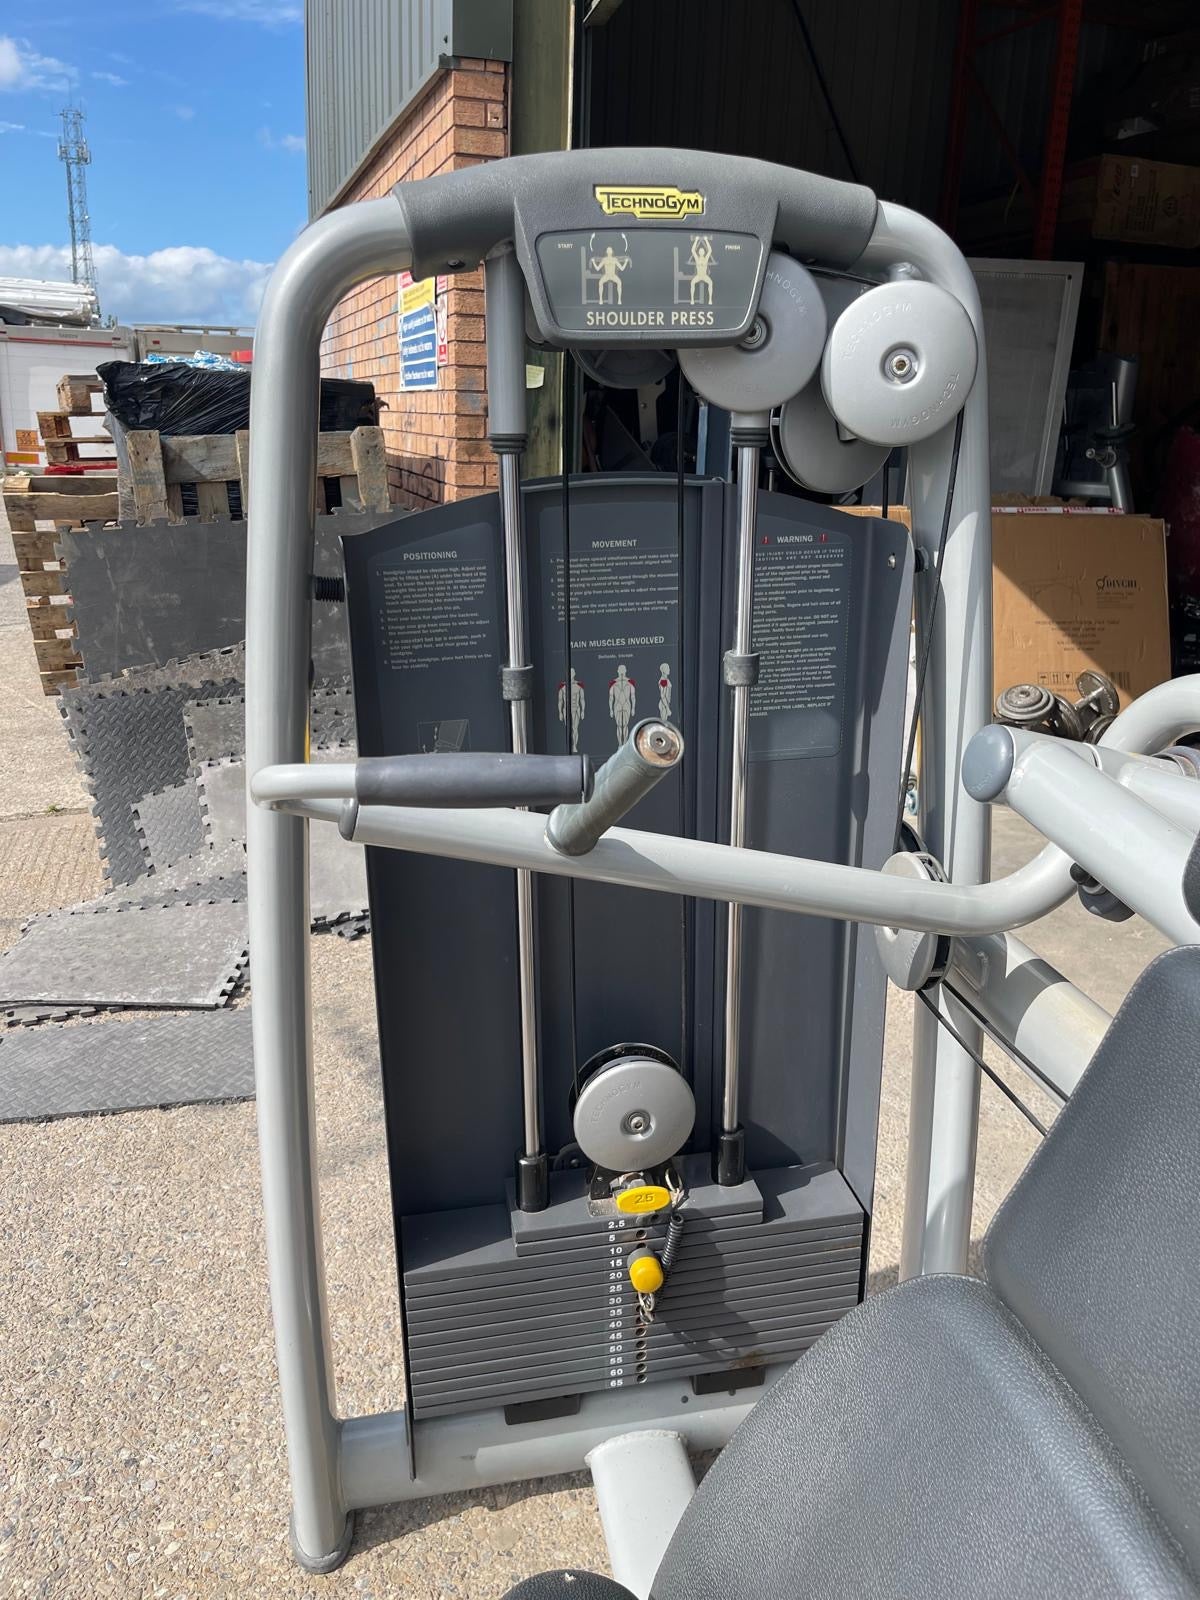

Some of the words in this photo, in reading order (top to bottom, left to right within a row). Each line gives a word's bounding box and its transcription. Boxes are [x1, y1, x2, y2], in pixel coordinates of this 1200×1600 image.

[600, 192, 699, 214] TECHNOGYM
[586, 311, 665, 326] SHOULDER
[671, 311, 714, 325] PRESS
[777, 535, 813, 543] WARNING
[592, 540, 637, 548] MOVEMENT
[403, 551, 457, 560] POSITIONING
[589, 639, 625, 648] MUSCLES
[628, 636, 664, 645] INVOLVED
[634, 1194, 653, 1204] 2.5
[609, 1259, 623, 1267] 15
[609, 1332, 622, 1340] 45
